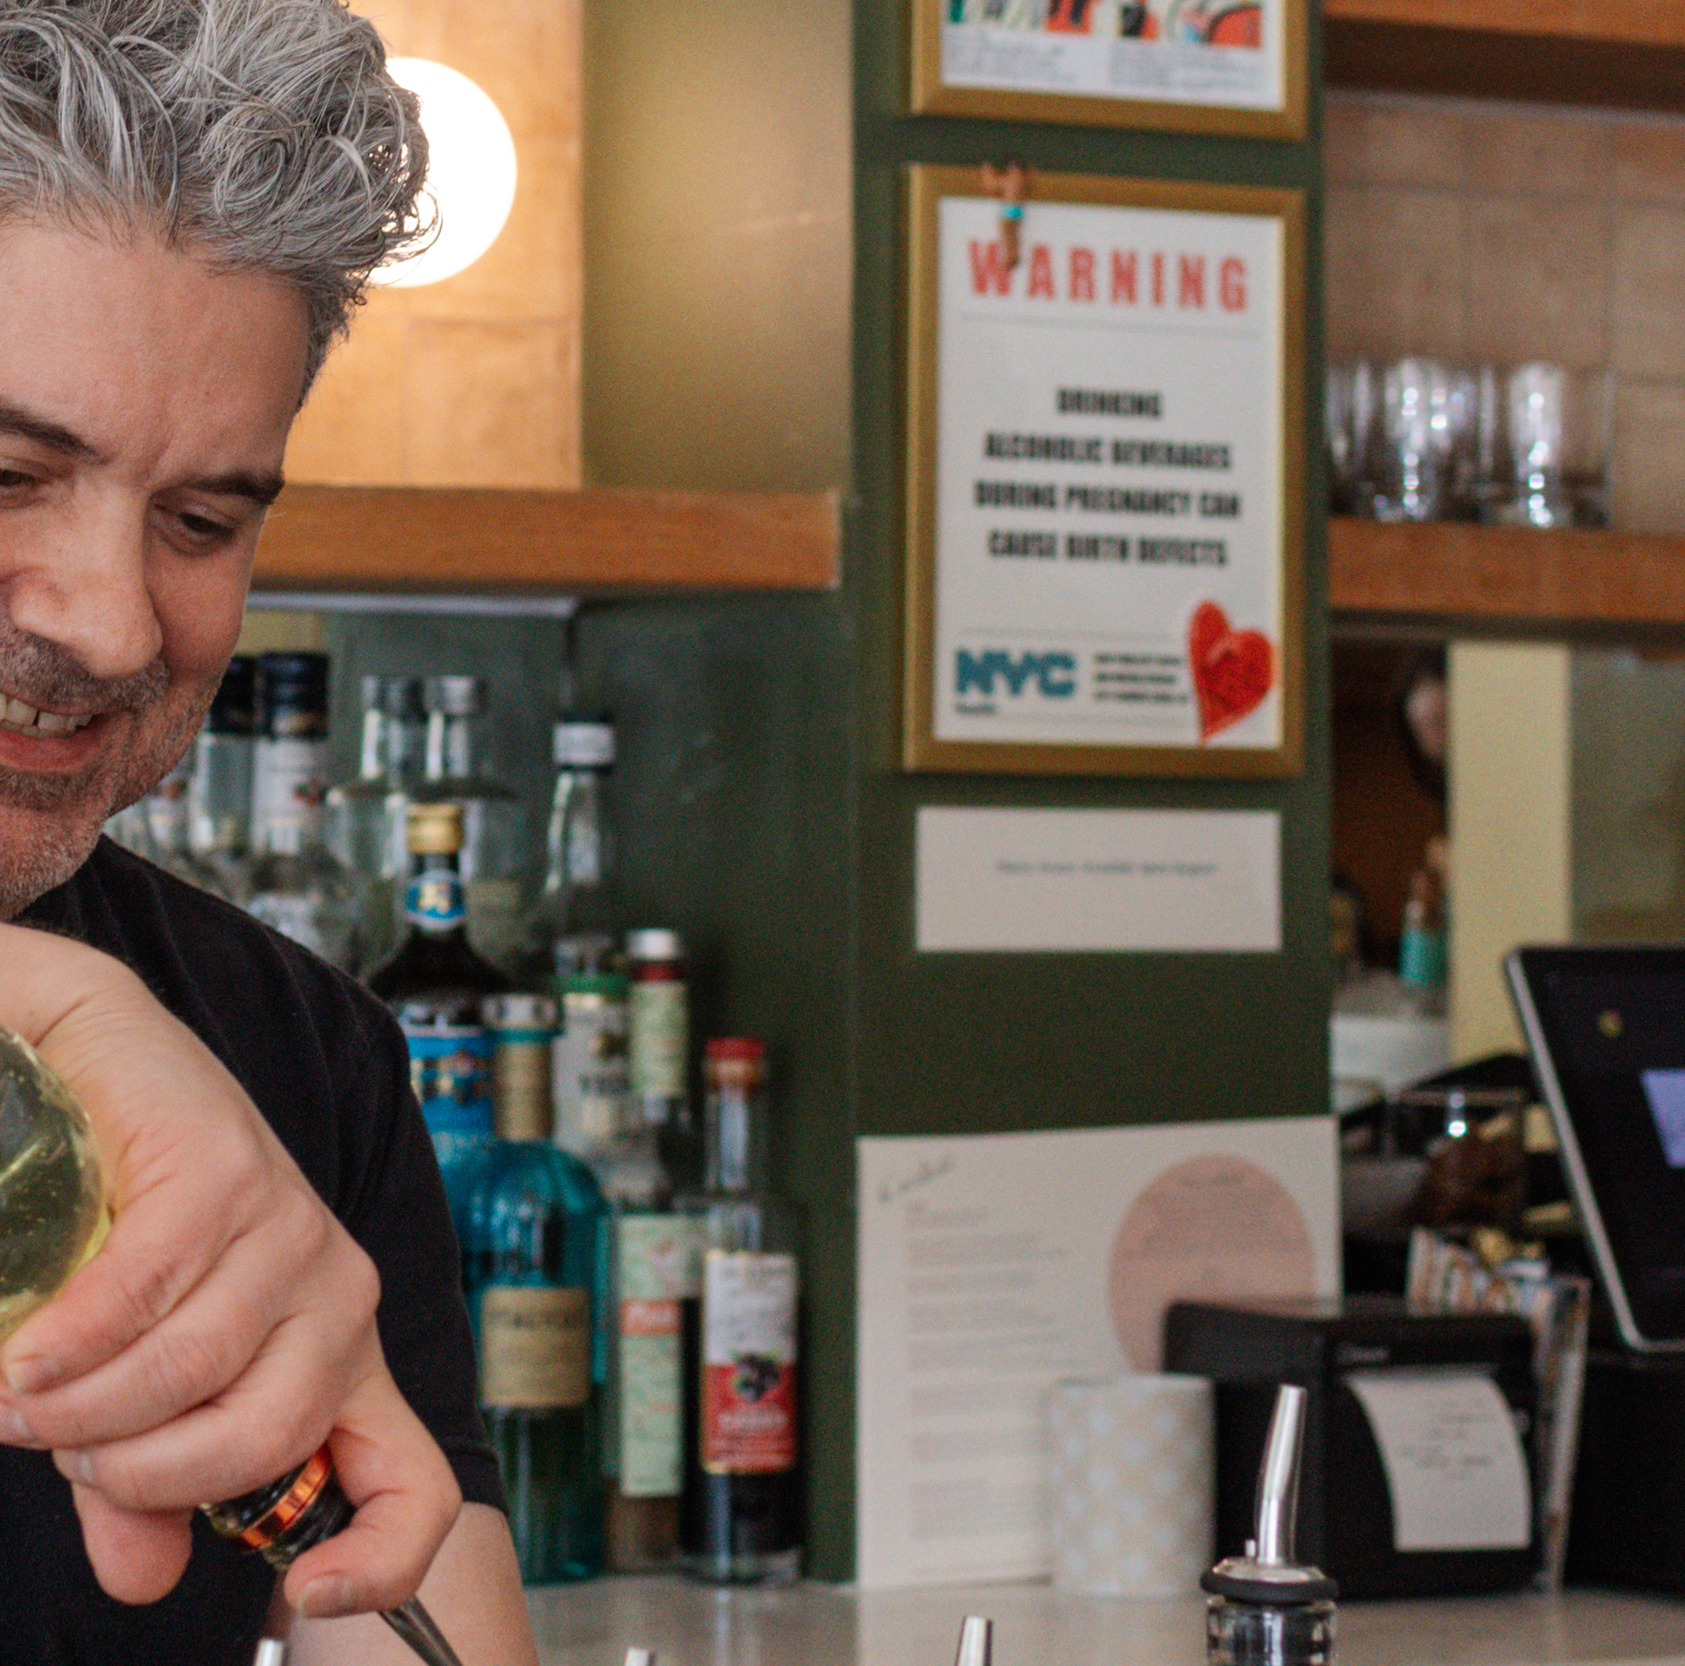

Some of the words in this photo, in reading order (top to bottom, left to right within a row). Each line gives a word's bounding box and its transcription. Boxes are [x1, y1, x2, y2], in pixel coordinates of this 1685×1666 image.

[968, 238, 1247, 312] WARNING
[1056, 387, 1162, 421] DRINKING
[983, 432, 1103, 464] ALCOHOLIC
[1112, 437, 1230, 471] BEVERAGES
[973, 481, 1057, 510] DURING
[1065, 486, 1191, 517] PREGNANCY
[1198, 491, 1240, 520] CAN
[987, 529, 1057, 560] CAUSE
[1065, 533, 1130, 562] BIRTH
[1138, 537, 1228, 568] DEFECTS
[955, 647, 1076, 699] NYC
